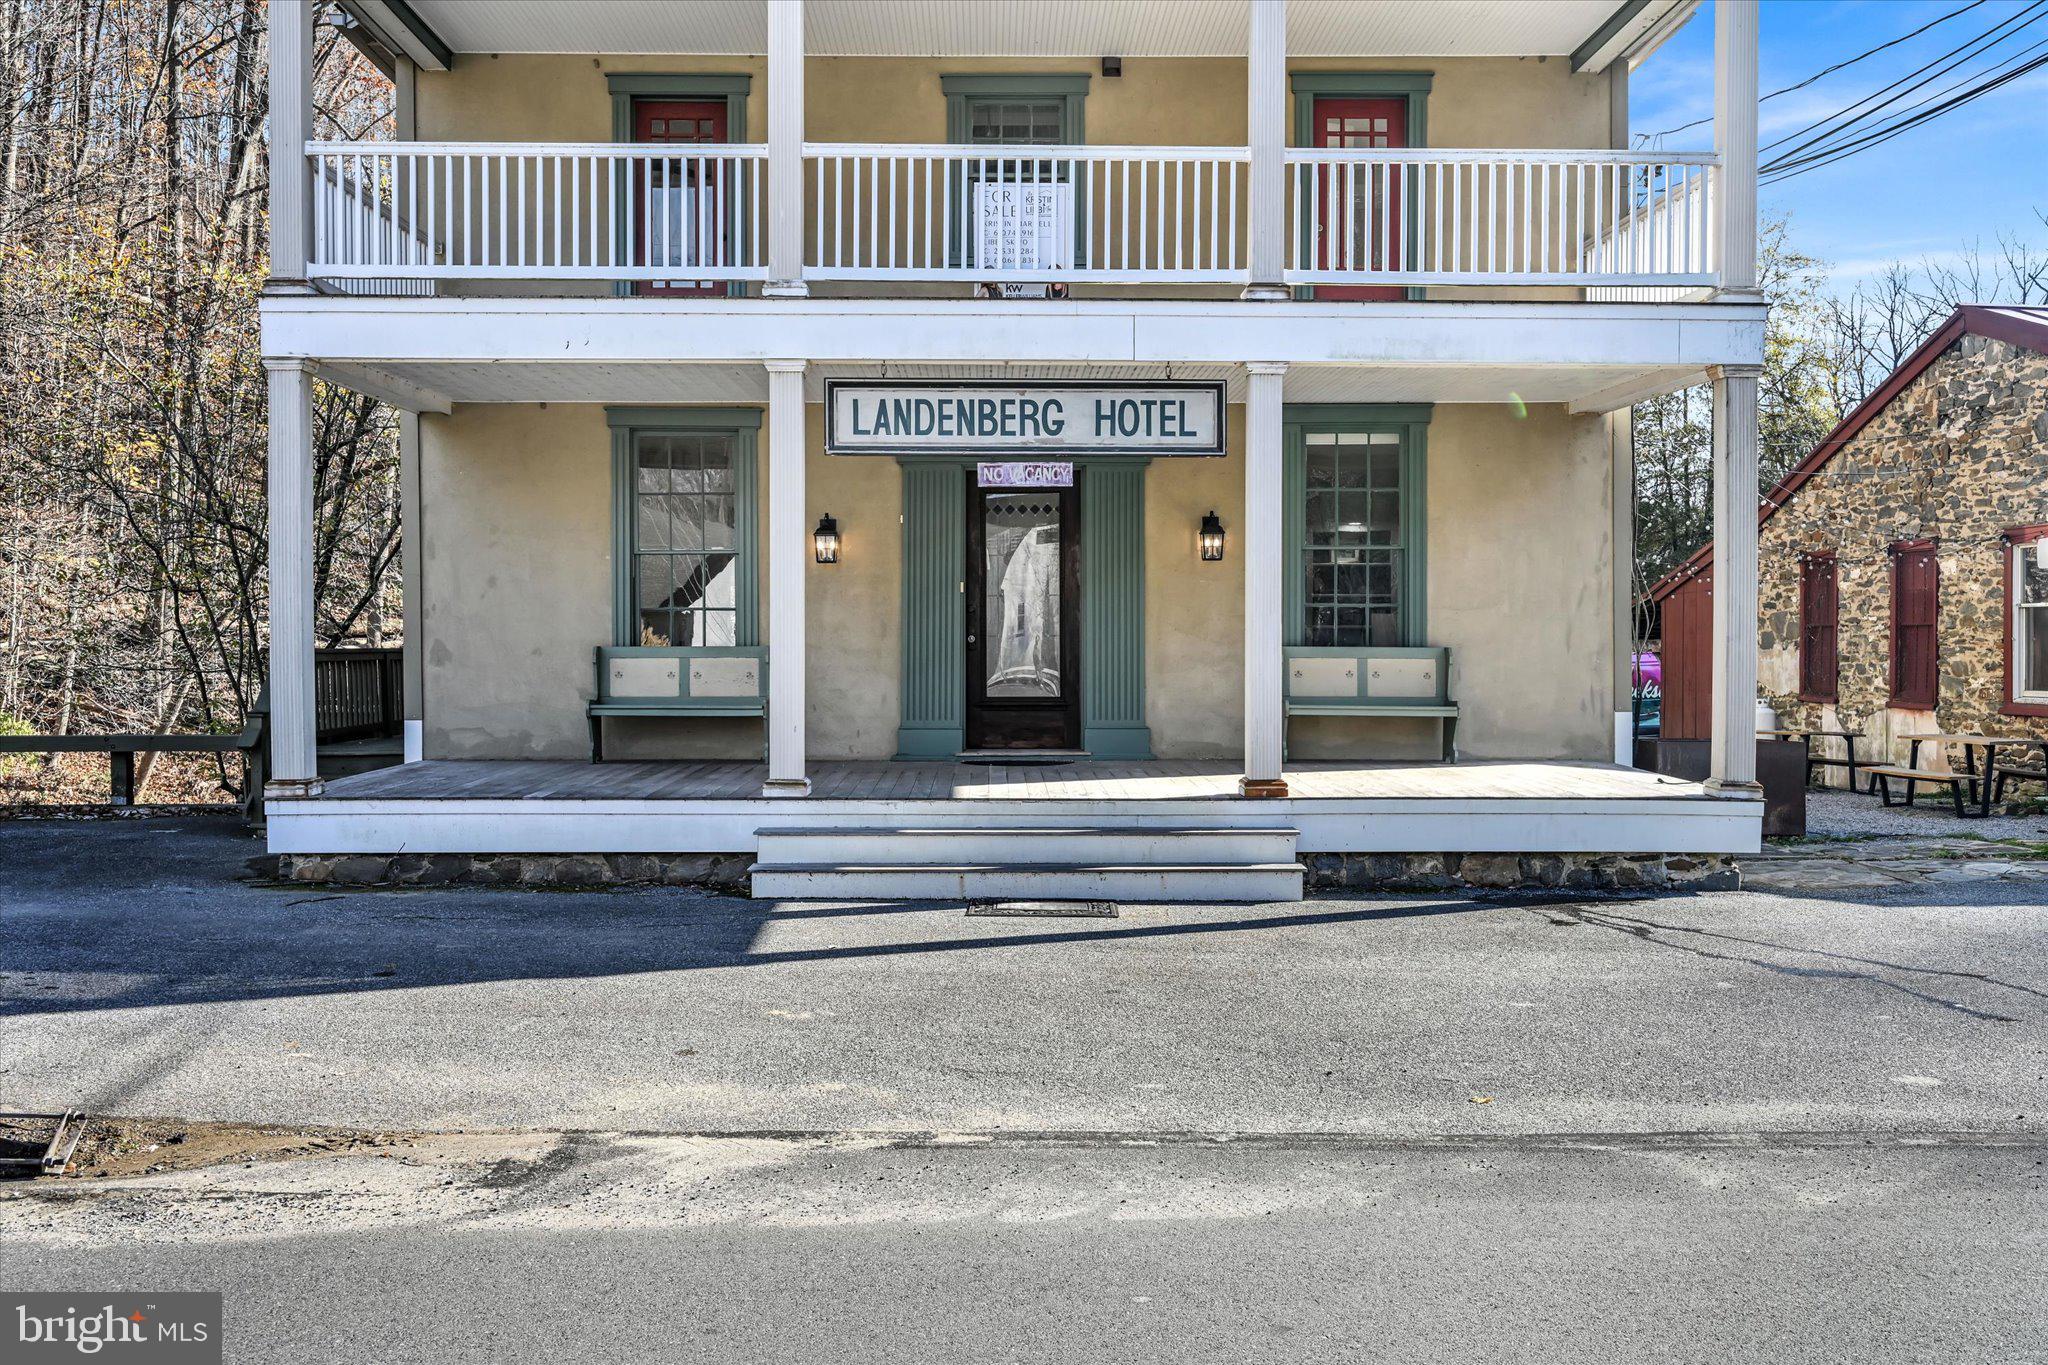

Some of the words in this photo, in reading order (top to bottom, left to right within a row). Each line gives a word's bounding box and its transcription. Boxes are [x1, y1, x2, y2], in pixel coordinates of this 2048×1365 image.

[852, 398, 1065, 437] LANDENBERG
[1094, 398, 1198, 437] HOTEL
[983, 466, 1004, 482] NO
